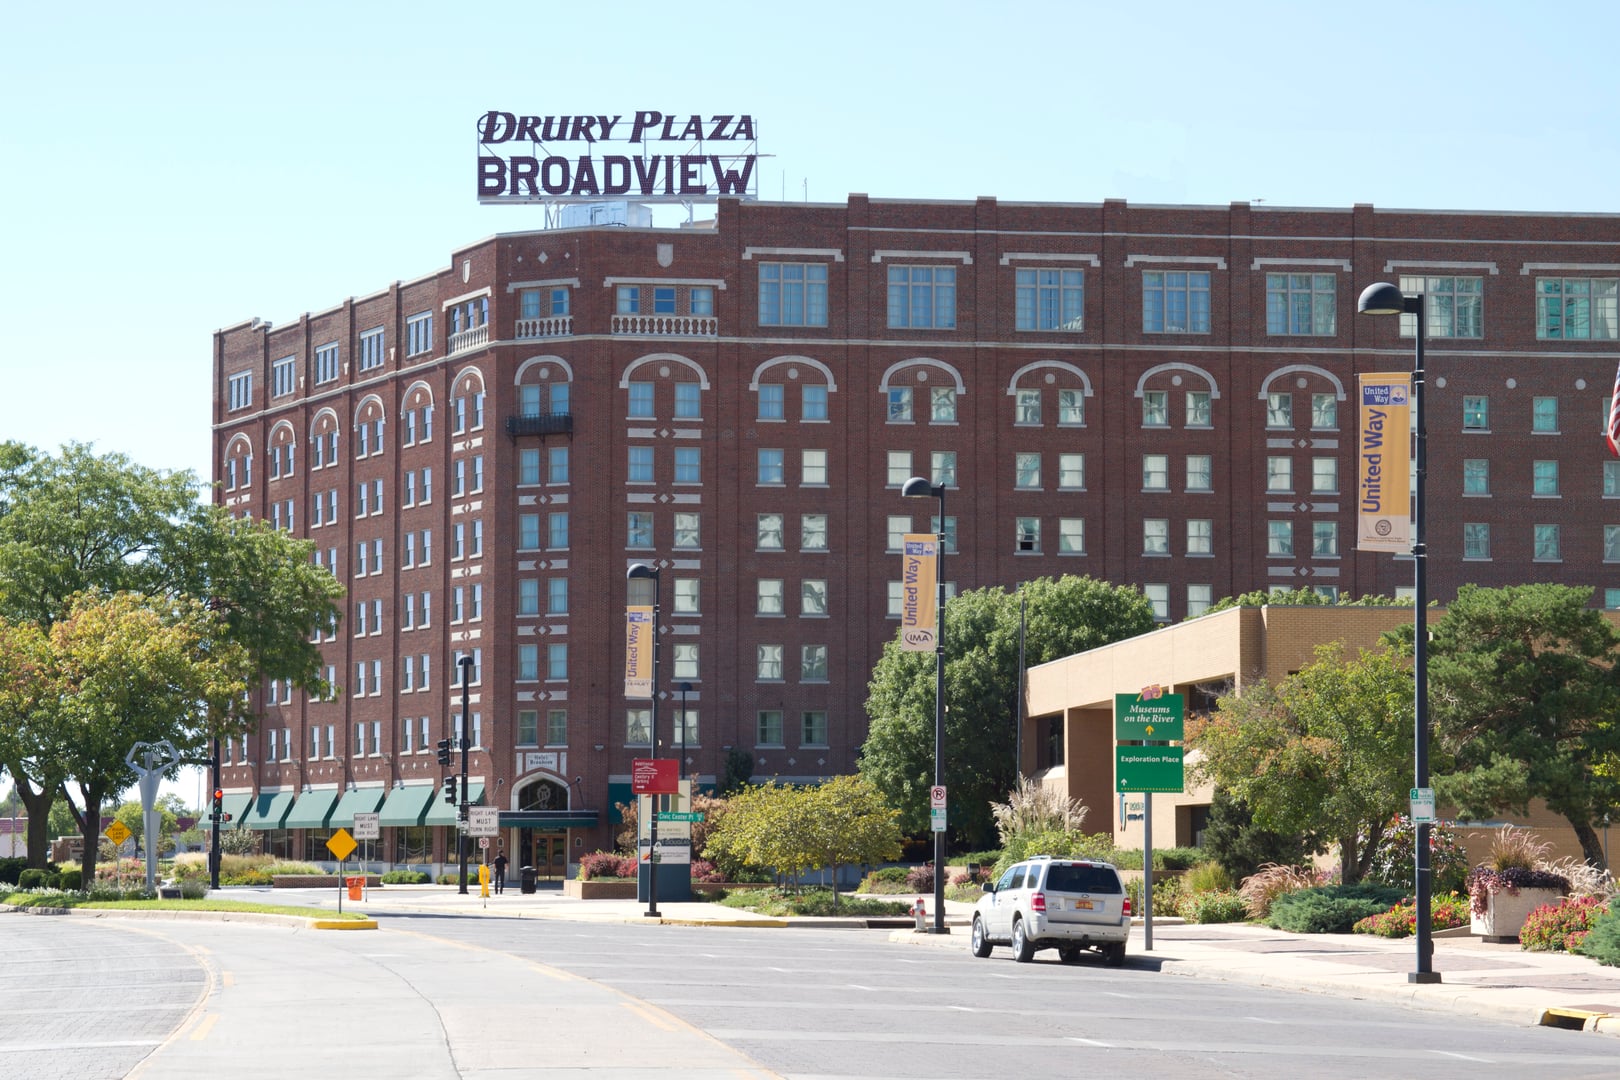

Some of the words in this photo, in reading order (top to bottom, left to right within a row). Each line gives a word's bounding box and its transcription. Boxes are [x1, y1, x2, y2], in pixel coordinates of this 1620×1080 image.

[477, 111, 622, 143] DRURY
[628, 111, 756, 143] PLAZA
[478, 155, 757, 195] BROADVIEW
[1364, 386, 1389, 395] United
[1374, 395, 1389, 405] Way
[1364, 409, 1387, 449] Way
[1362, 454, 1382, 512] United
[906, 558, 921, 583] Way
[905, 587, 917, 627] United
[628, 623, 641, 645] Way
[627, 646, 638, 678] United
[1123, 715, 1136, 723] on
[1136, 714, 1151, 723] the
[1151, 714, 1175, 723] River
[1129, 704, 1171, 714] Museums
[1120, 755, 1161, 764] Exploration
[1161, 755, 1180, 763] Place
[671, 813, 688, 821] Center
